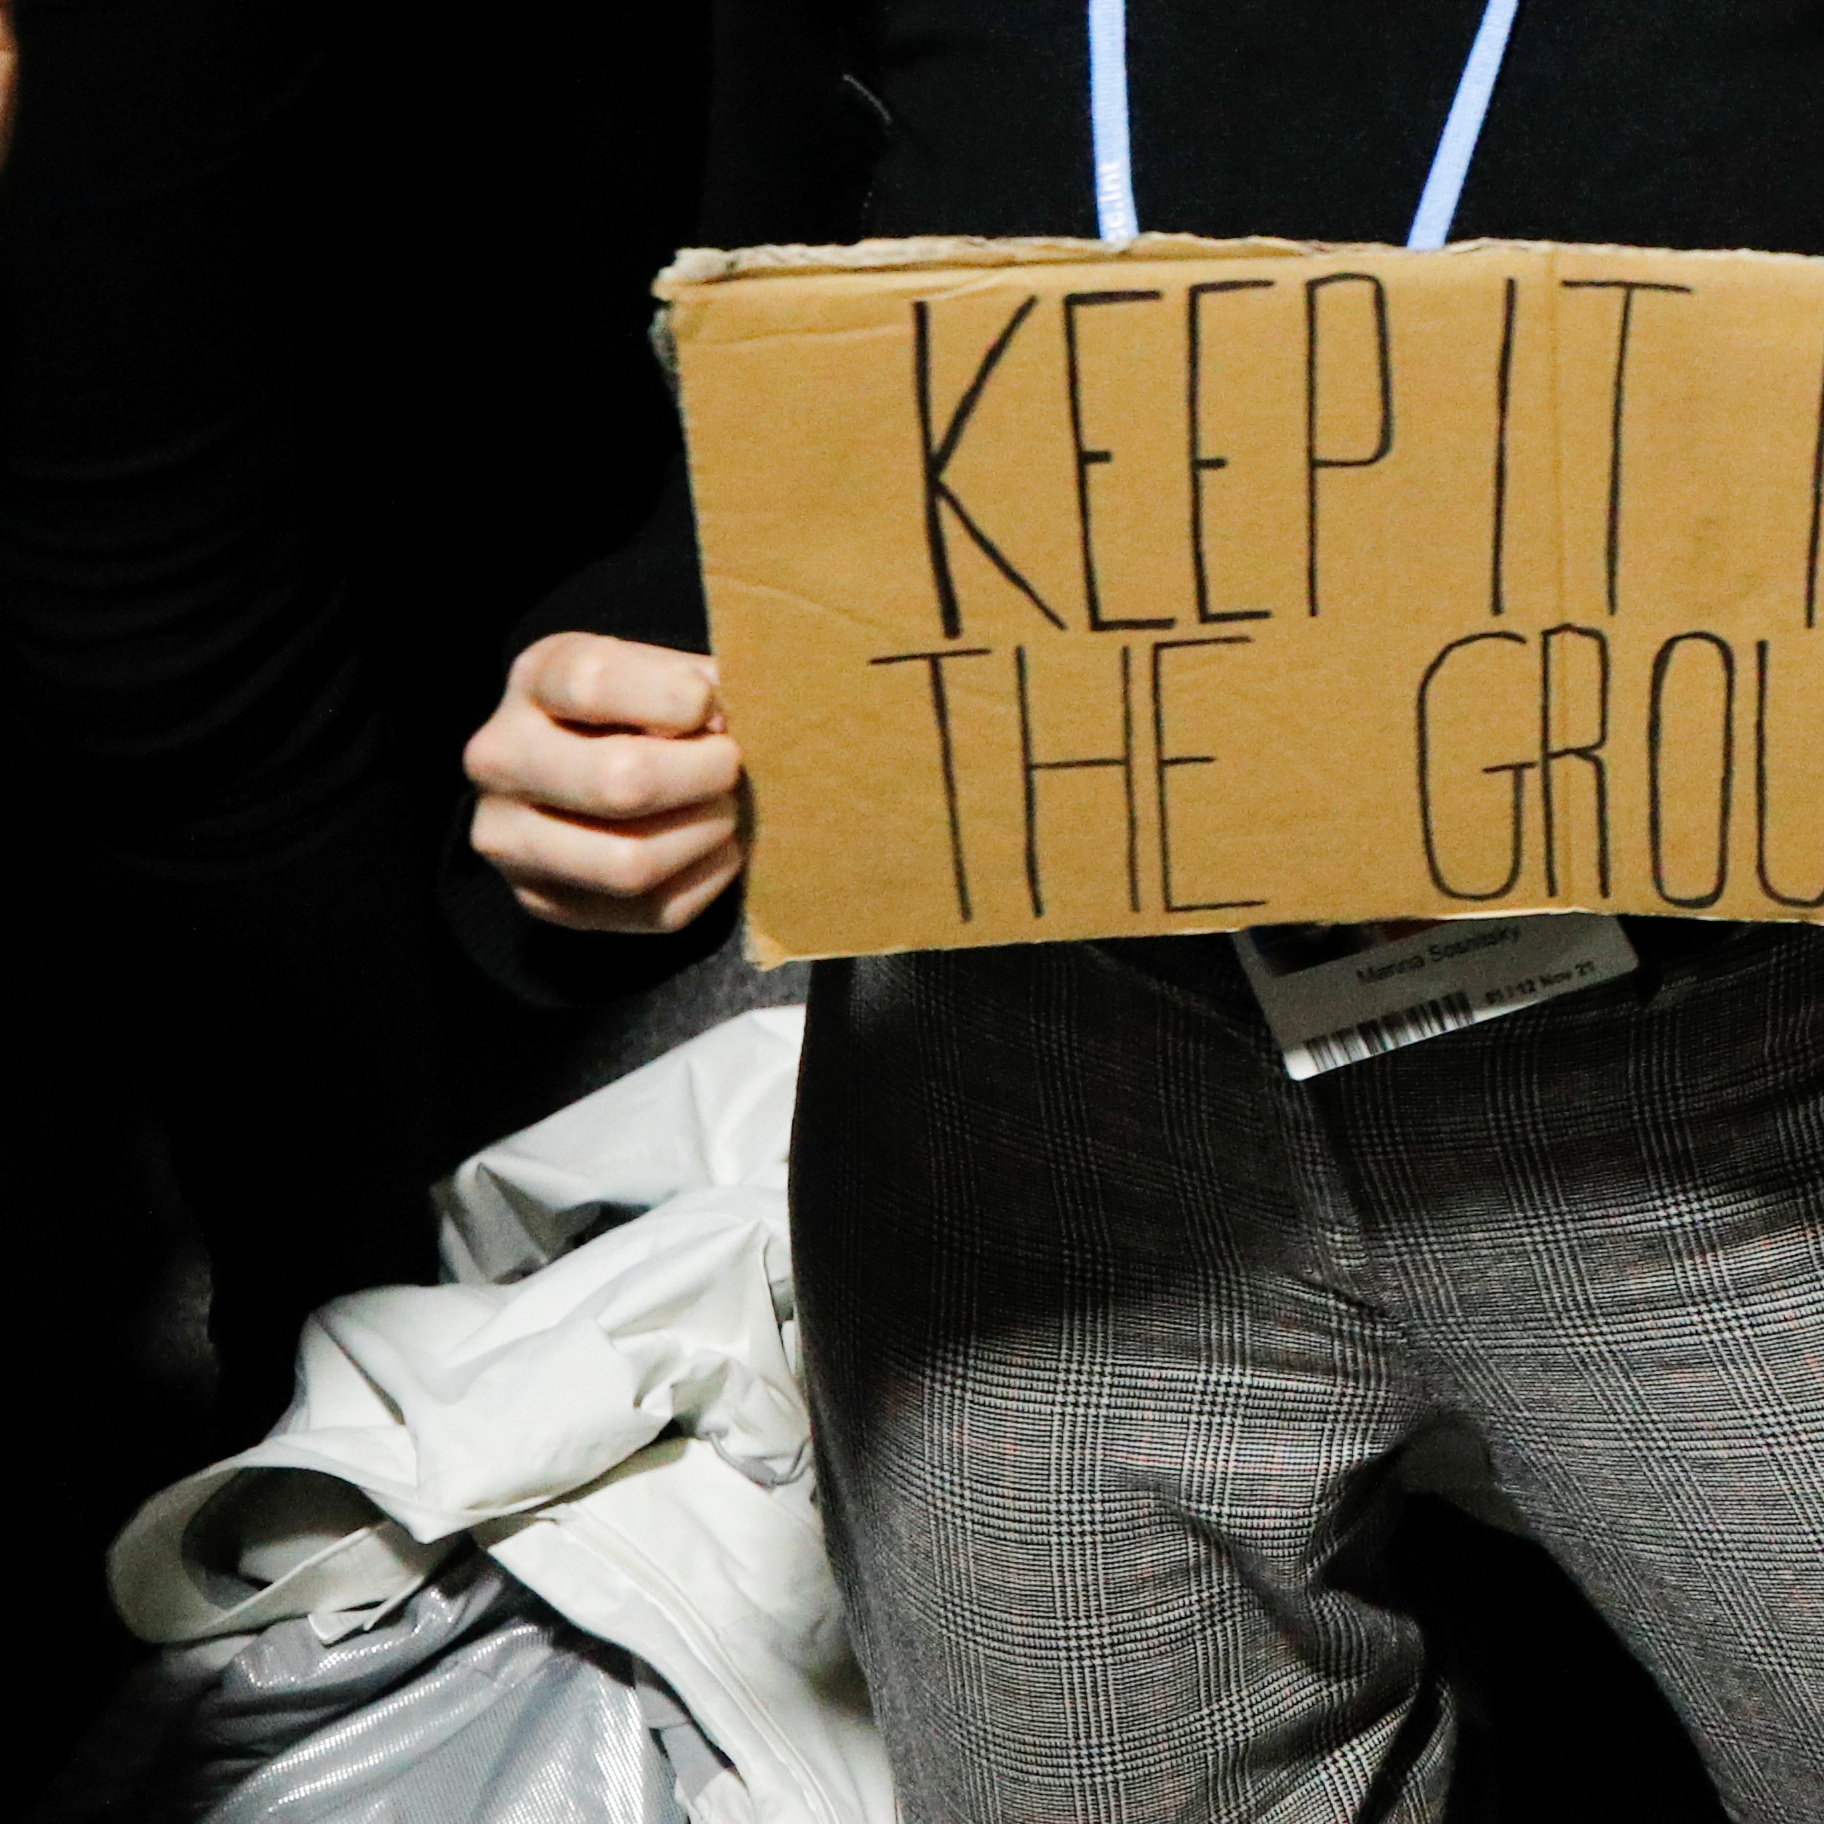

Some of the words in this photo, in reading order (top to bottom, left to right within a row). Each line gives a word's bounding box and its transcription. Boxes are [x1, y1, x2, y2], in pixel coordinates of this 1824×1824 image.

[912, 273, 1393, 641] KEEP
[1490, 278, 1692, 617] IT
[868, 635, 1268, 923] THE
